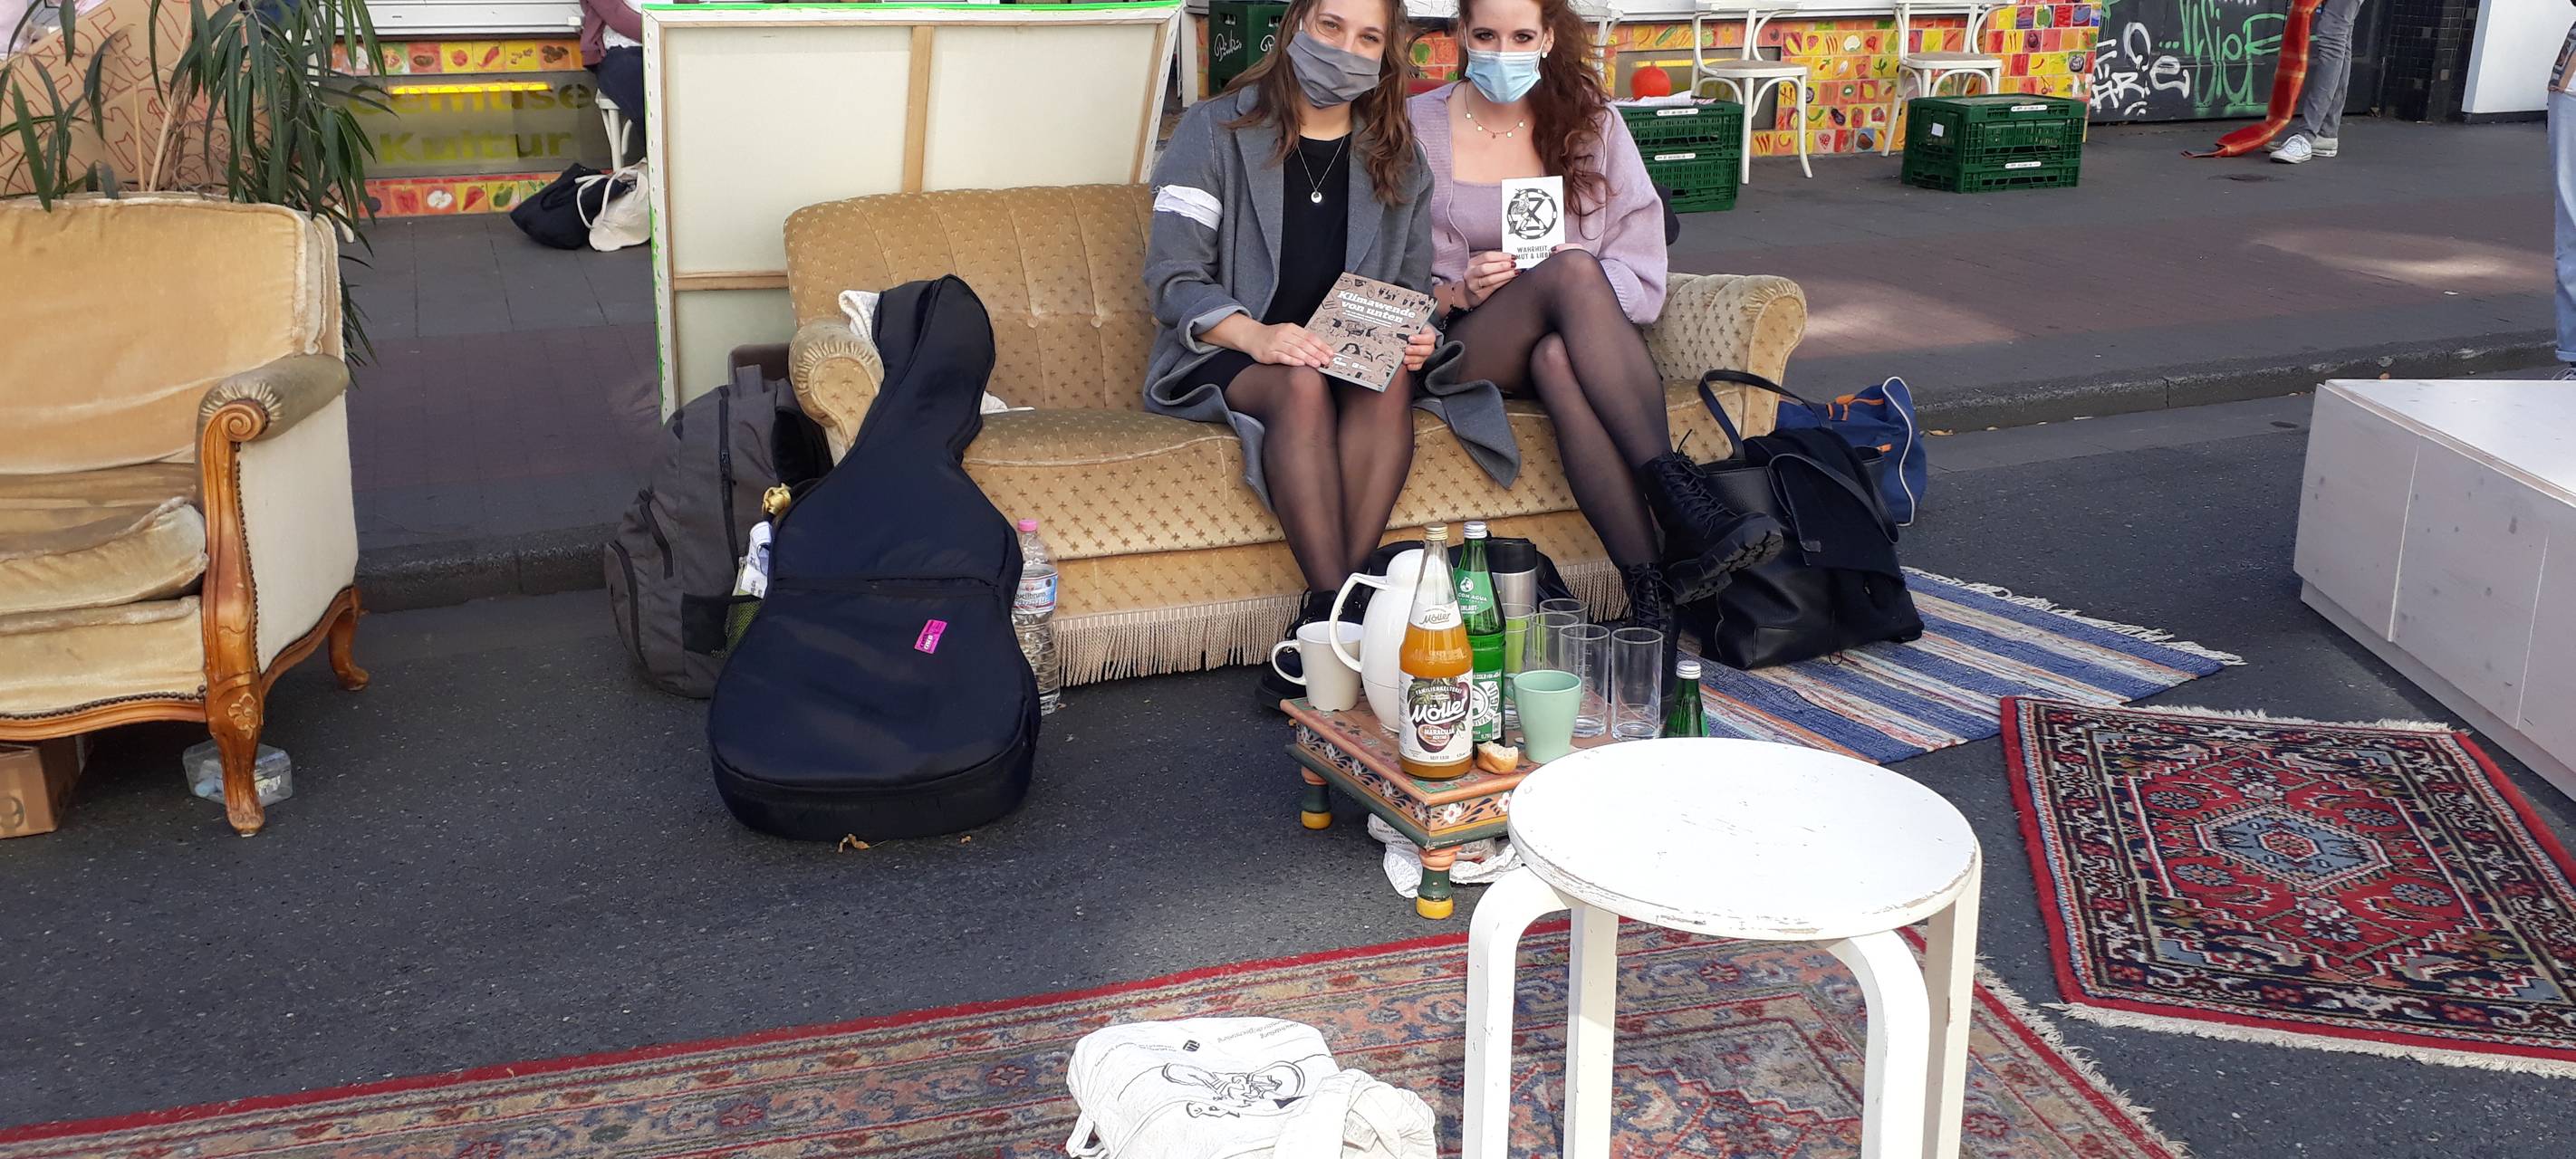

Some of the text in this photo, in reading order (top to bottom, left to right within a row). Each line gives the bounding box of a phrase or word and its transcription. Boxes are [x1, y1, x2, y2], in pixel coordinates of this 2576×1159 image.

[380, 130, 572, 163] Kultur
[1516, 245, 1551, 254] WAHRHEIT,
[1337, 291, 1417, 319] Klimawende
[1341, 302, 1365, 312] von
[1366, 308, 1404, 324] unten
[1419, 612, 1452, 625] Möller
[1410, 695, 1468, 724] Möller
